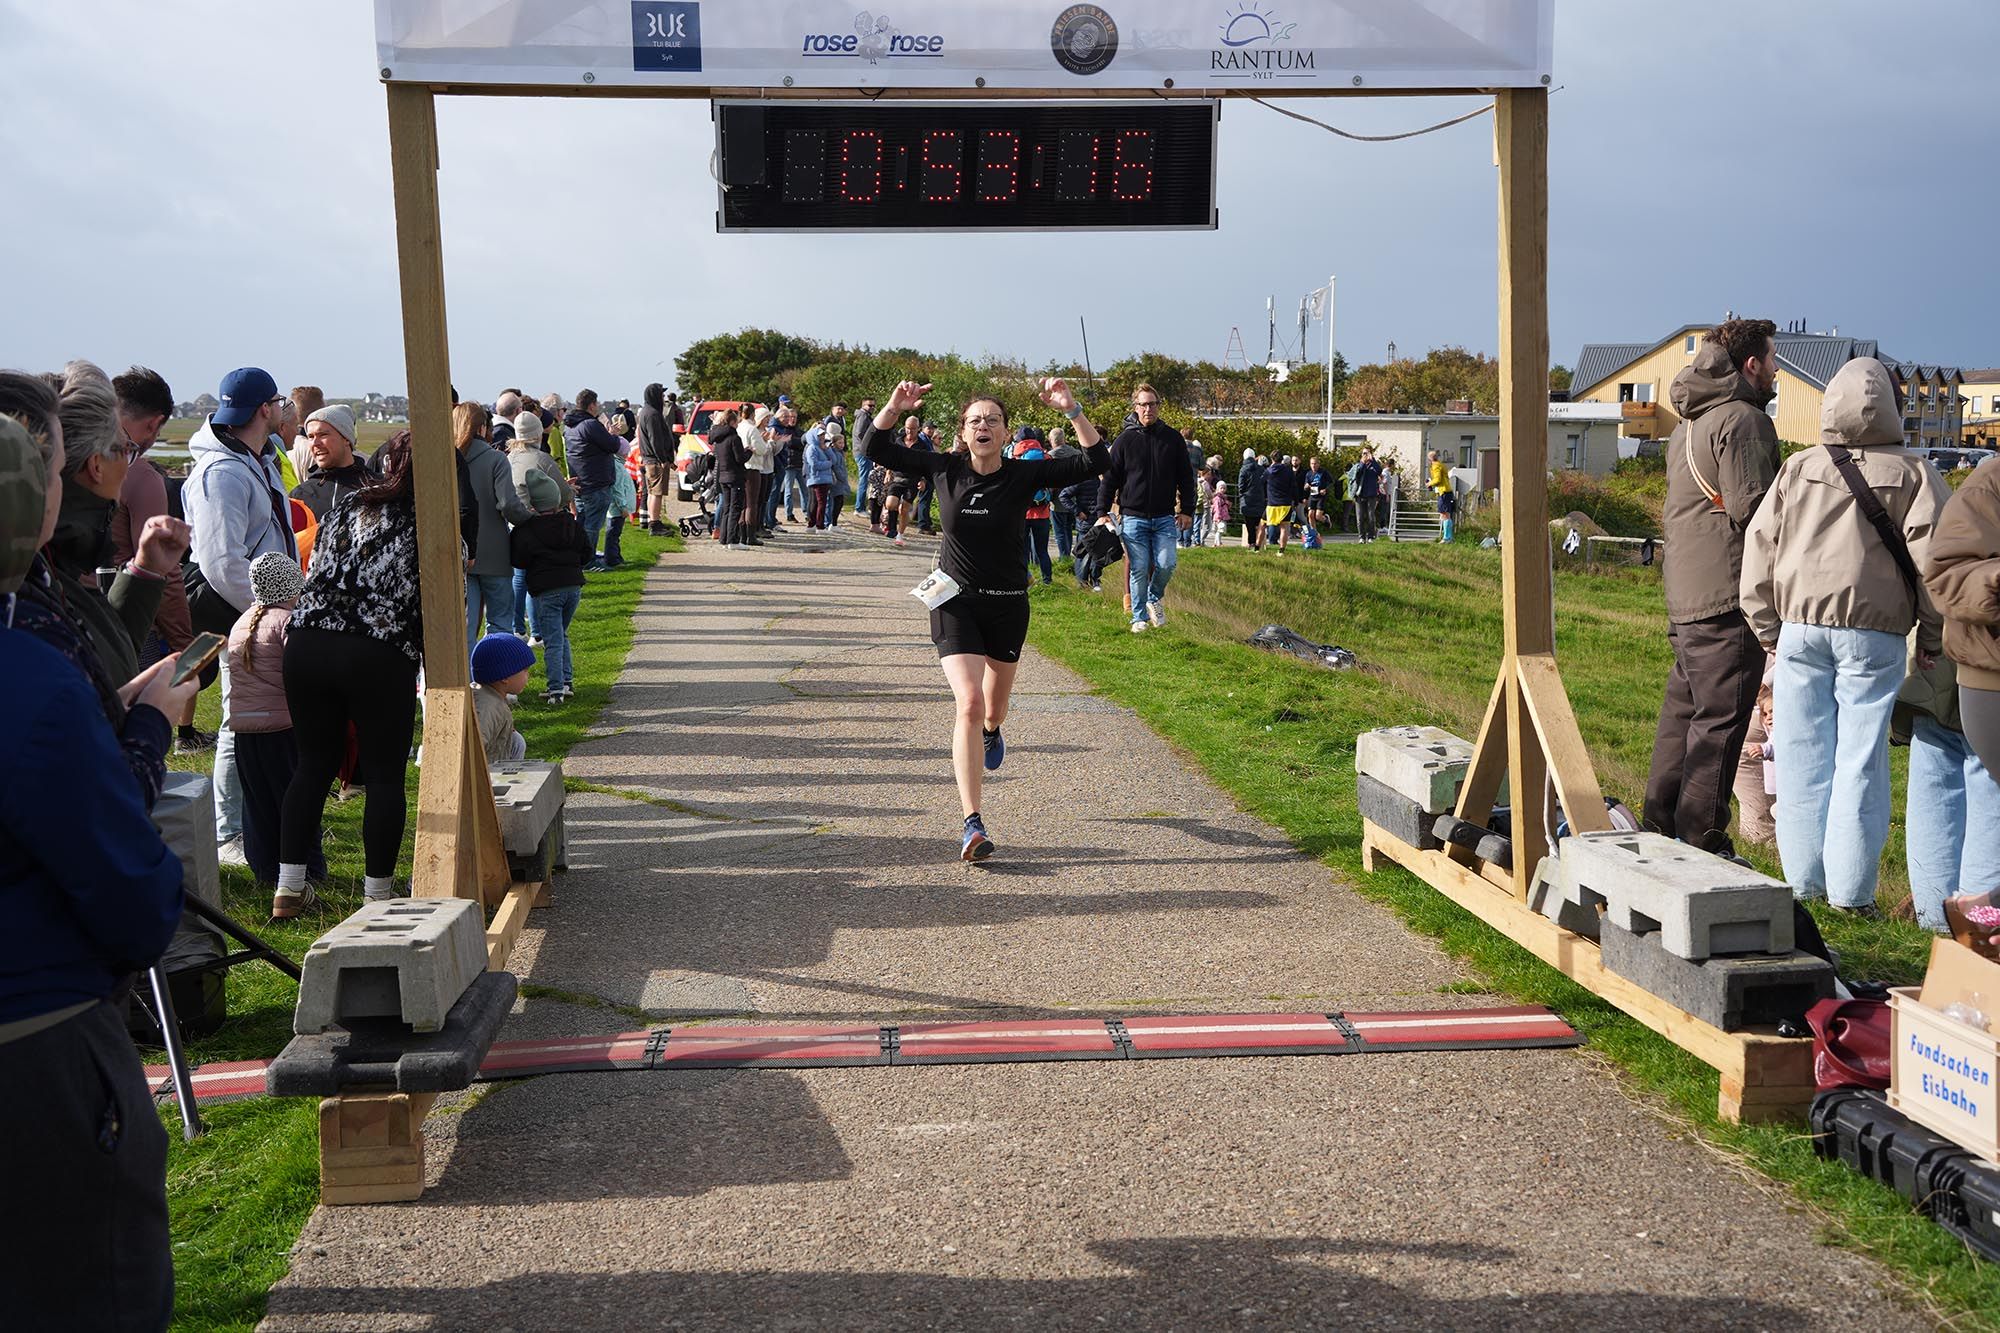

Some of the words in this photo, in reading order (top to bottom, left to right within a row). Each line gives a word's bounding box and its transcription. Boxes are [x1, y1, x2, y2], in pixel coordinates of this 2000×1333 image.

[1055, 6, 1087, 36] FRIESEN
[1090, 7, 1115, 35] BANDE
[653, 40, 664, 48] TUI
[665, 40, 681, 48] BLUE
[803, 34, 858, 52] rose
[889, 35, 944, 52] rose
[1211, 50, 1315, 70] RANTUM
[1252, 72, 1274, 80] SYLT
[1911, 1033, 1989, 1086] Fundsachen
[1922, 1073, 1977, 1118] Eisbahn
